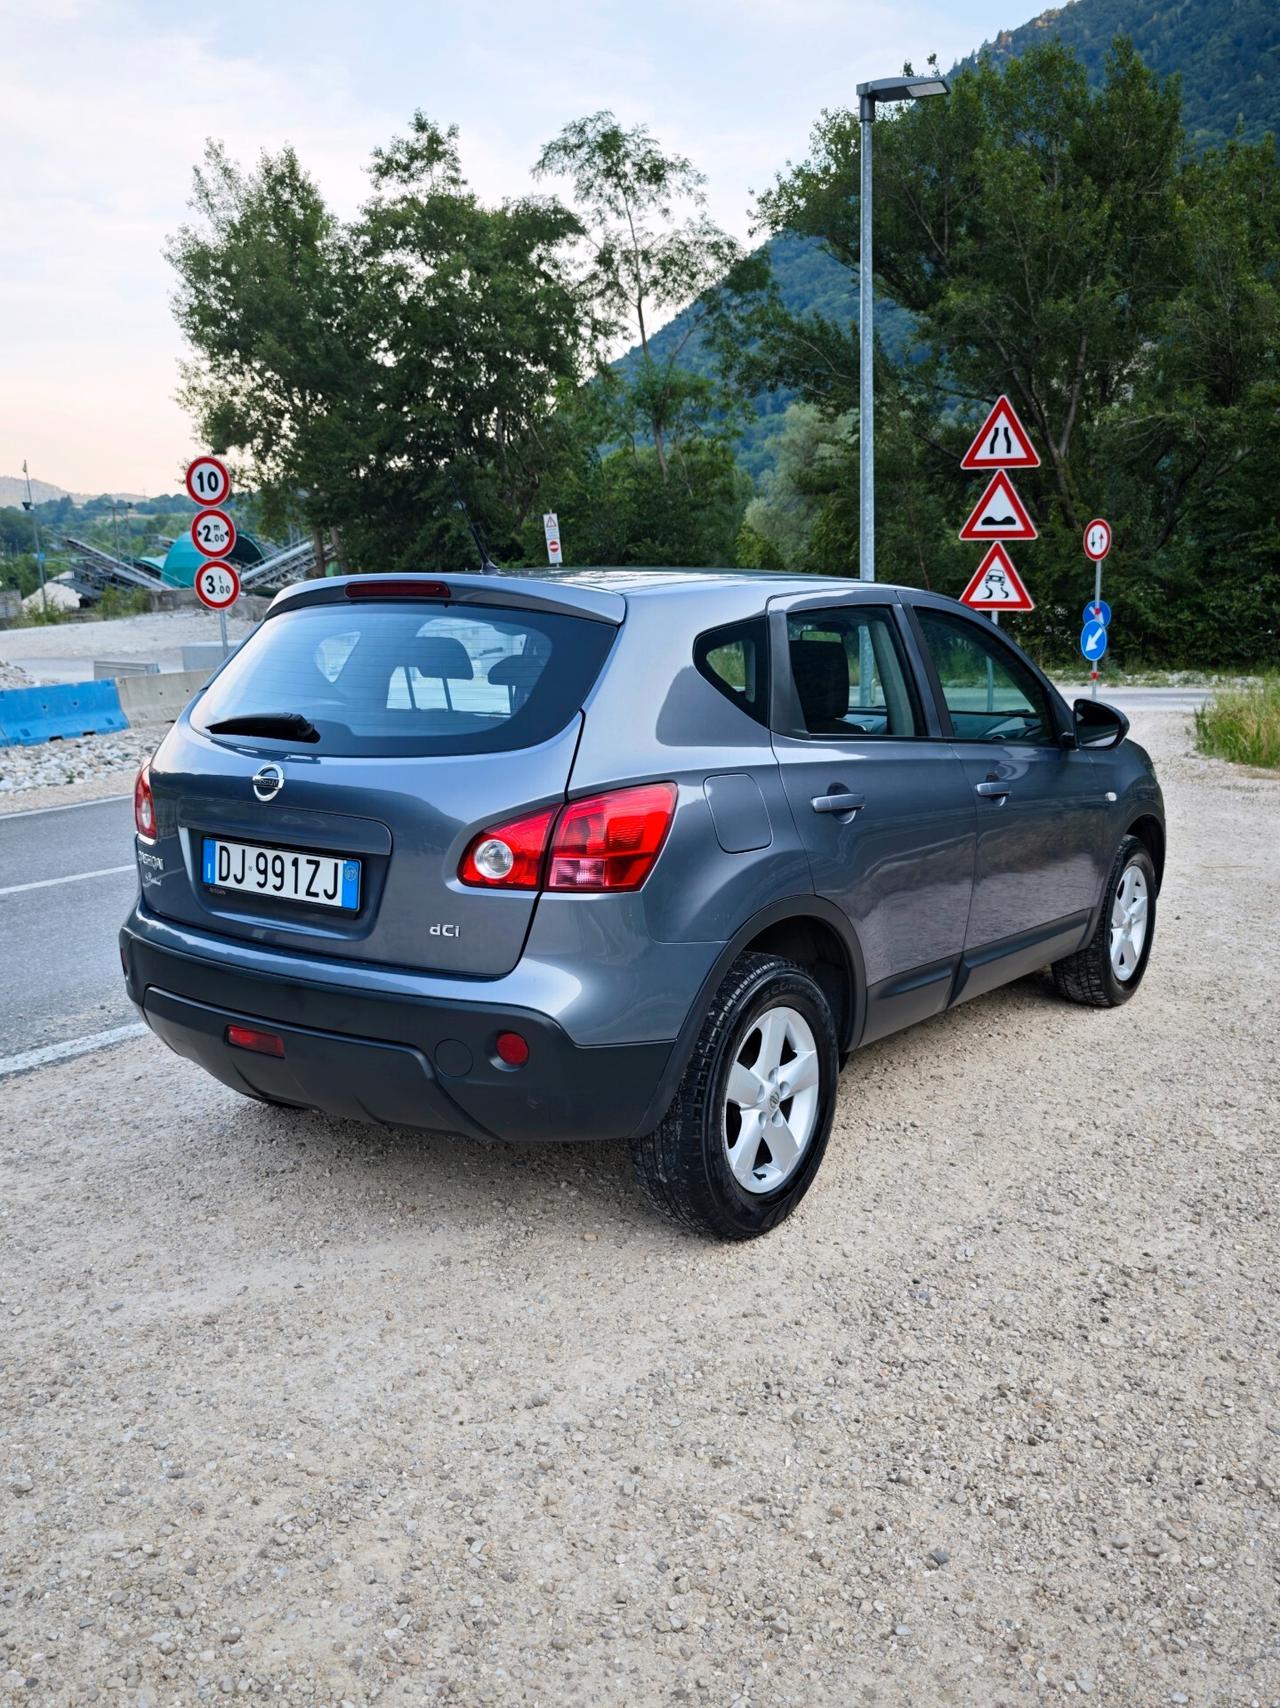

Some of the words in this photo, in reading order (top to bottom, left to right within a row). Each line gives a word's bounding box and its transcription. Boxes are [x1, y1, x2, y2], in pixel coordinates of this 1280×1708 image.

[197, 471, 219, 492] 10
[219, 846, 245, 884] DJ
[256, 852, 338, 900] 991ZJ
[430, 924, 459, 937] dCi
